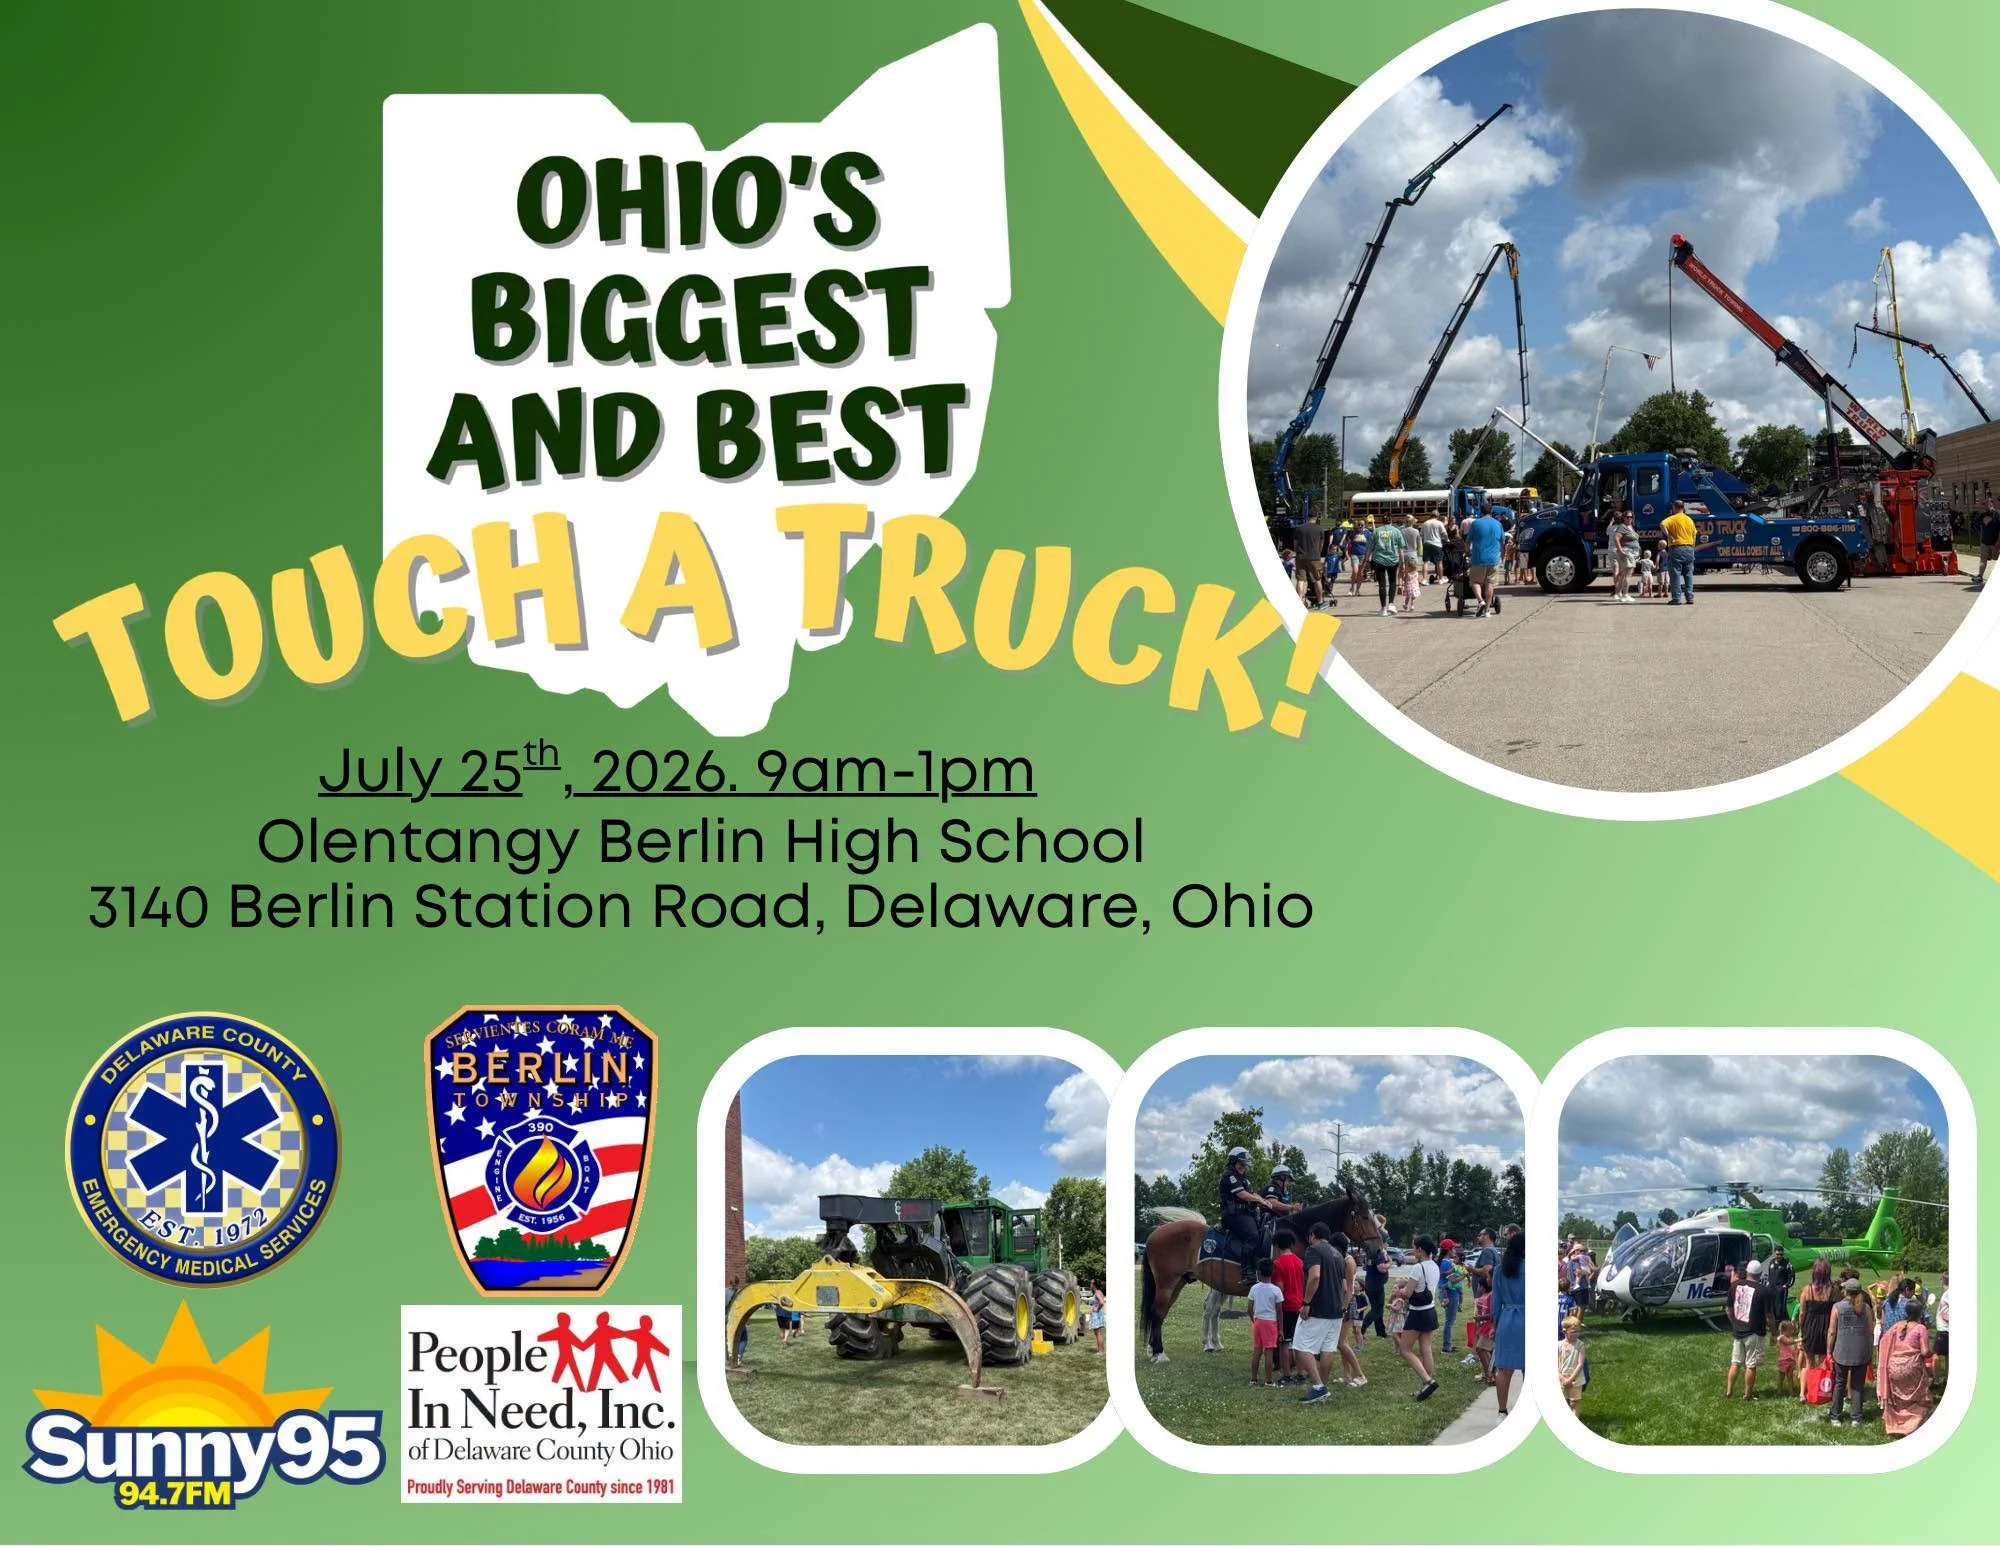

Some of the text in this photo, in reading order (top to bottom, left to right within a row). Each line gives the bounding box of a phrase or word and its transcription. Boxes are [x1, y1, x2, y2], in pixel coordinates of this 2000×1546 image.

[518, 151, 881, 249] OHIO'S
[472, 266, 930, 364] BIGGEST
[426, 383, 966, 490] AND BEST
[1847, 407, 1881, 440] TRUCK
[1718, 520, 1748, 535] TRUCK
[54, 503, 1341, 737] TOUCH A TRUCK!
[319, 746, 443, 803] July
[593, 750, 738, 797] 2026.
[757, 750, 1033, 804] 9am-1pm
[258, 817, 1142, 875] Olentangy Berlin High School
[89, 882, 1313, 935] 3140 Berlin Station Road, Delaware, Ohio
[100, 1025, 307, 1085] DELAWARE COUNTY
[445, 1020, 635, 1049] SERVIENTES CORAM ME
[452, 1052, 629, 1084] BERLIN
[454, 1092, 629, 1108] TOWNSHIP
[528, 1121, 554, 1133] 390
[82, 1178, 327, 1277] EMERGENCY MEDICAL SERVICES
[138, 1207, 269, 1247] EST. 1972
[518, 1213, 566, 1225] EST. 1956
[408, 1330, 548, 1385] People
[408, 1386, 676, 1437] In Need, Inc.
[408, 1437, 674, 1467] of Delaware County Ohio
[118, 1481, 232, 1506] 94.7FM
[407, 1478, 674, 1498] Proudly Serving Delaware County since 1981
